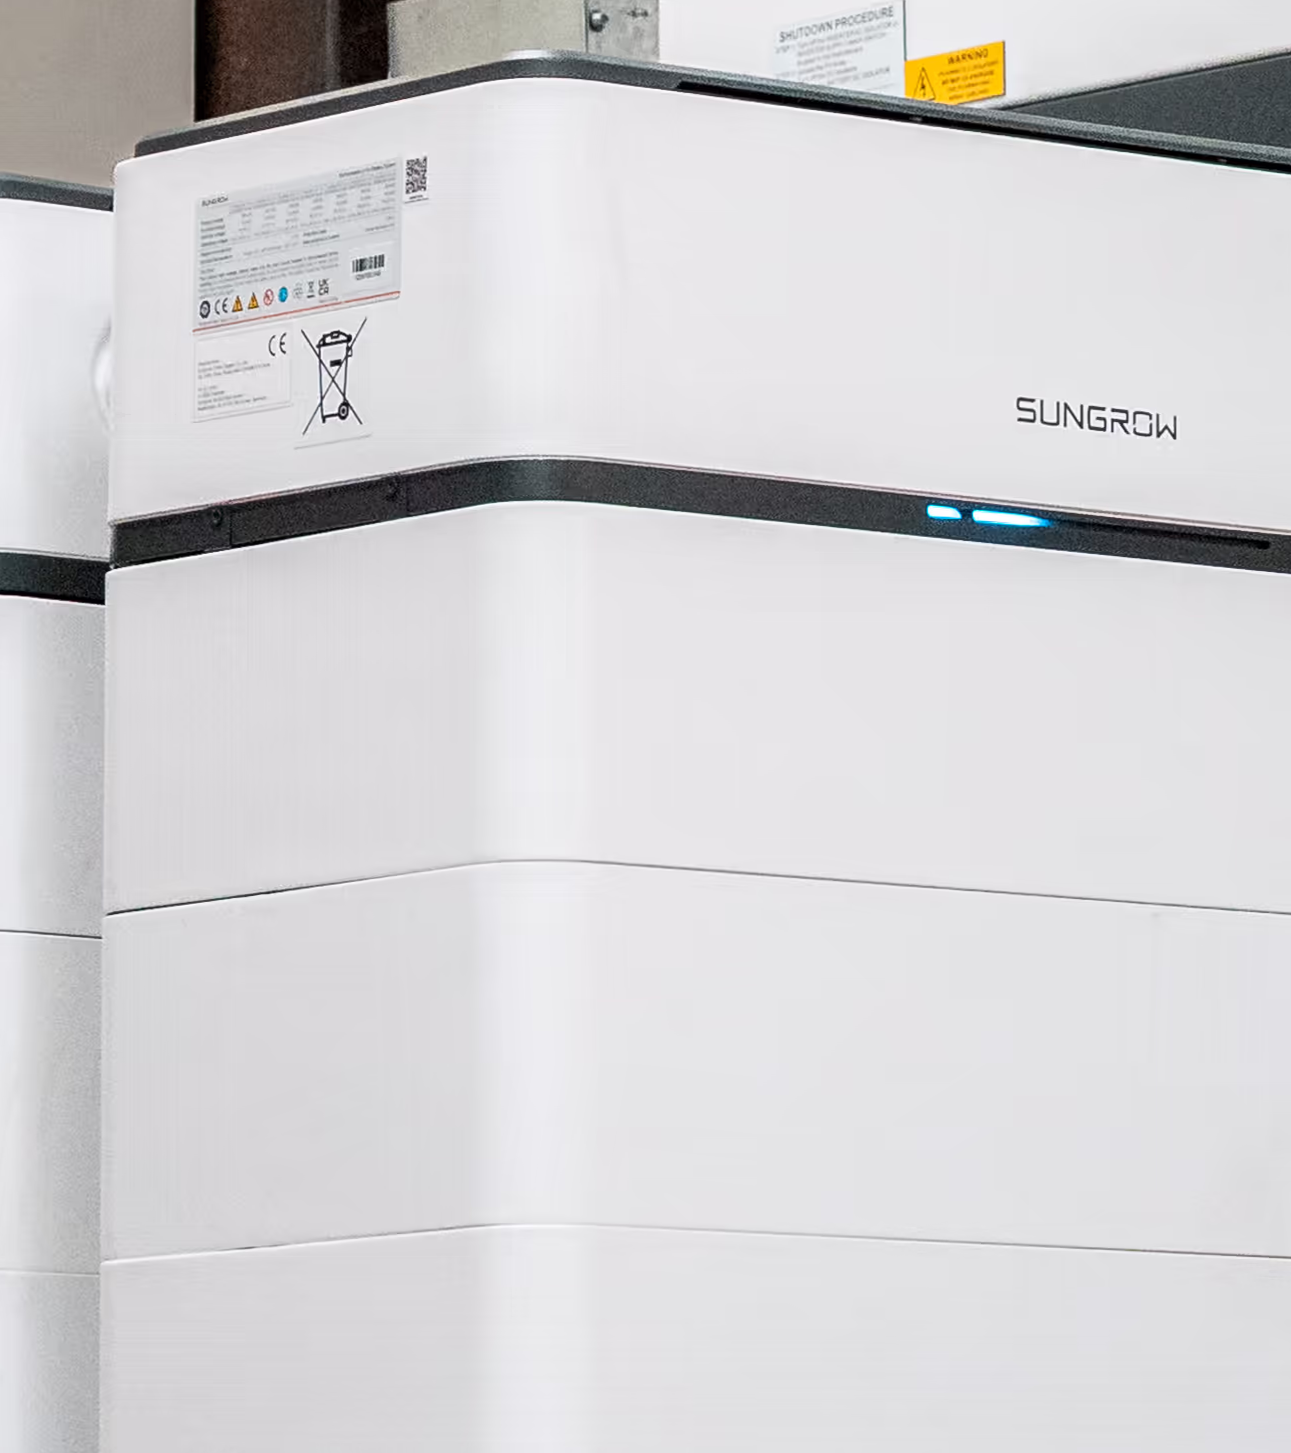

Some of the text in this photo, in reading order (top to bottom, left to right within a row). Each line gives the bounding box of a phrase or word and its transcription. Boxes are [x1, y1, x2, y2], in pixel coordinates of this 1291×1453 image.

[779, 21, 833, 43] SHUTDOWN
[835, 5, 894, 29] PROCEDURE
[947, 48, 988, 66] WARNING
[1016, 397, 1178, 440] SUNGROW
